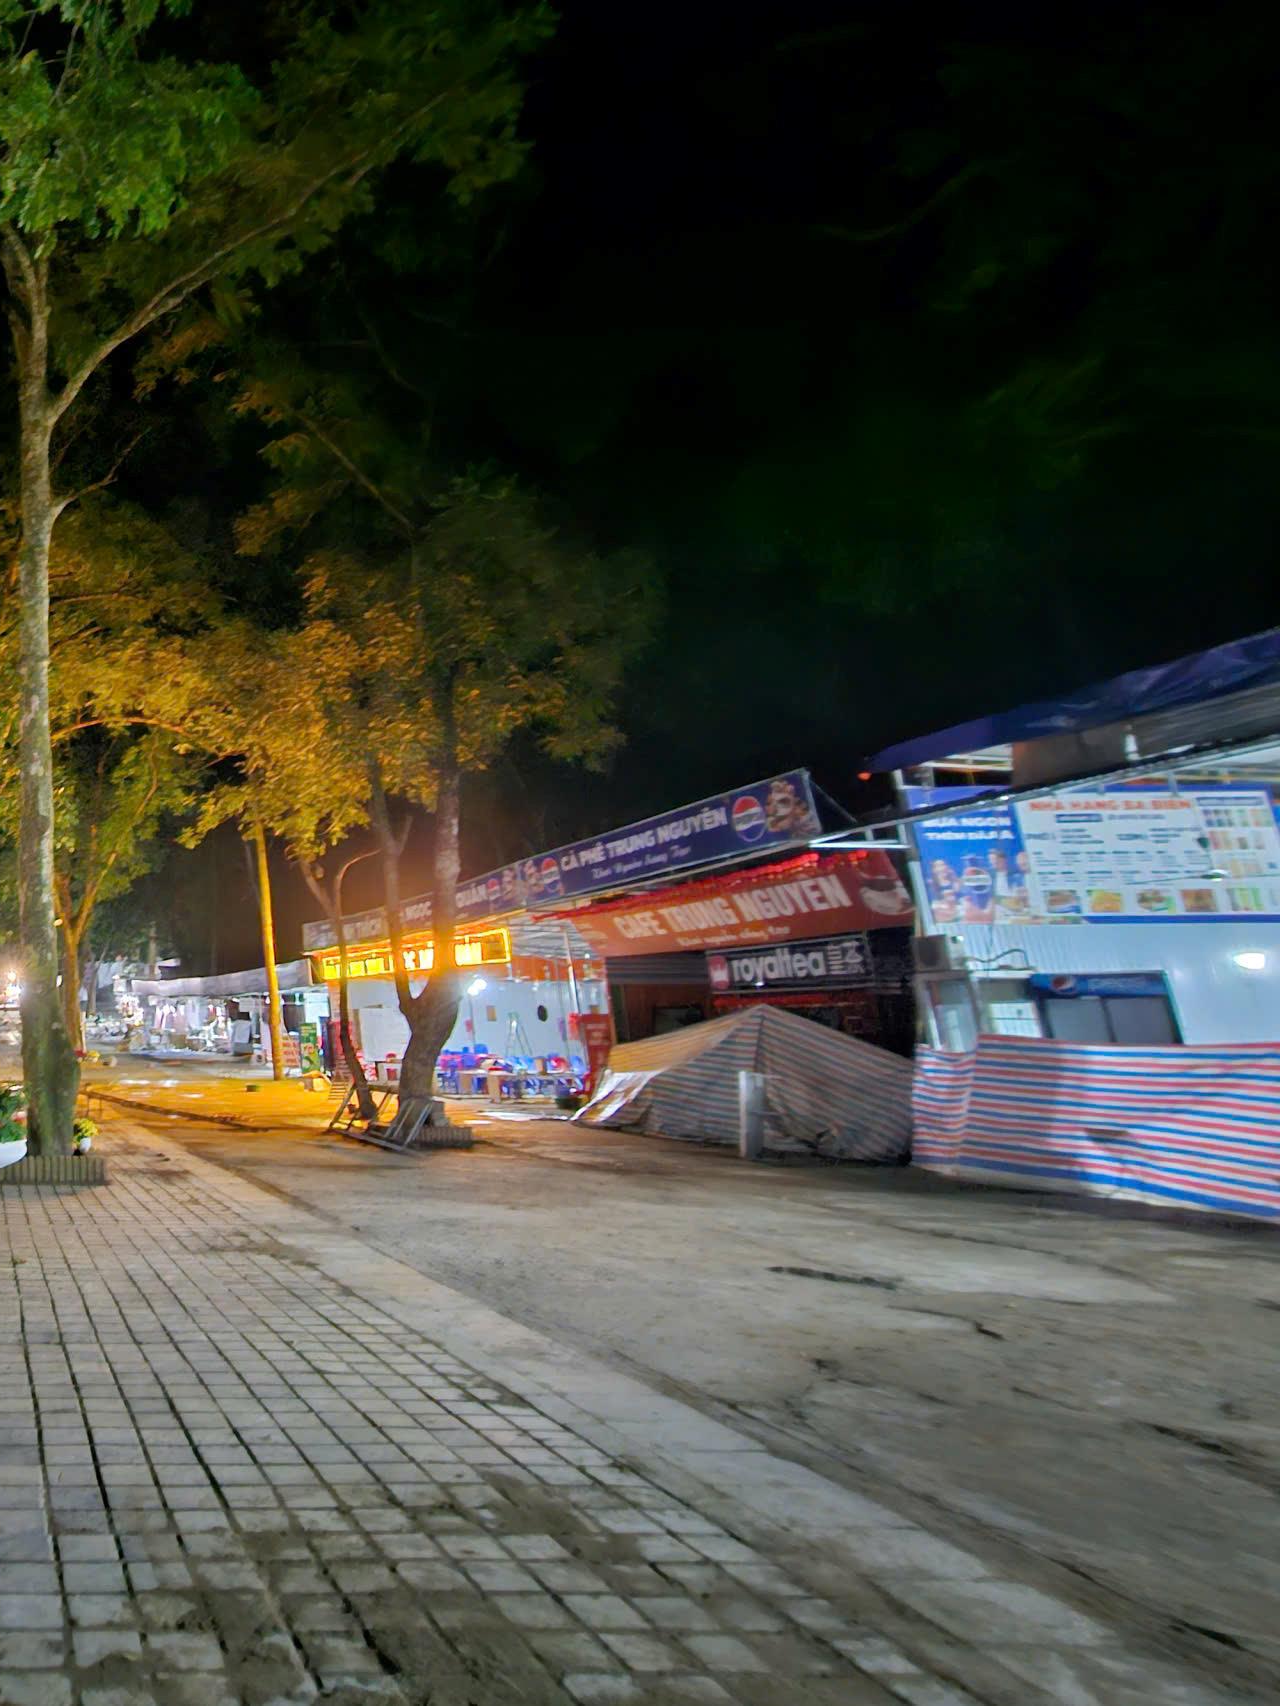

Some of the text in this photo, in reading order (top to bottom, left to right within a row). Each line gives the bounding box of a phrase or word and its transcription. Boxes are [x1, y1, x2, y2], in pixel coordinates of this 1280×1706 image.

[605, 829, 656, 859] TRUNG
[612, 910, 669, 939] CAFE
[657, 896, 740, 933] TRUNG
[730, 948, 827, 983] royaltea
